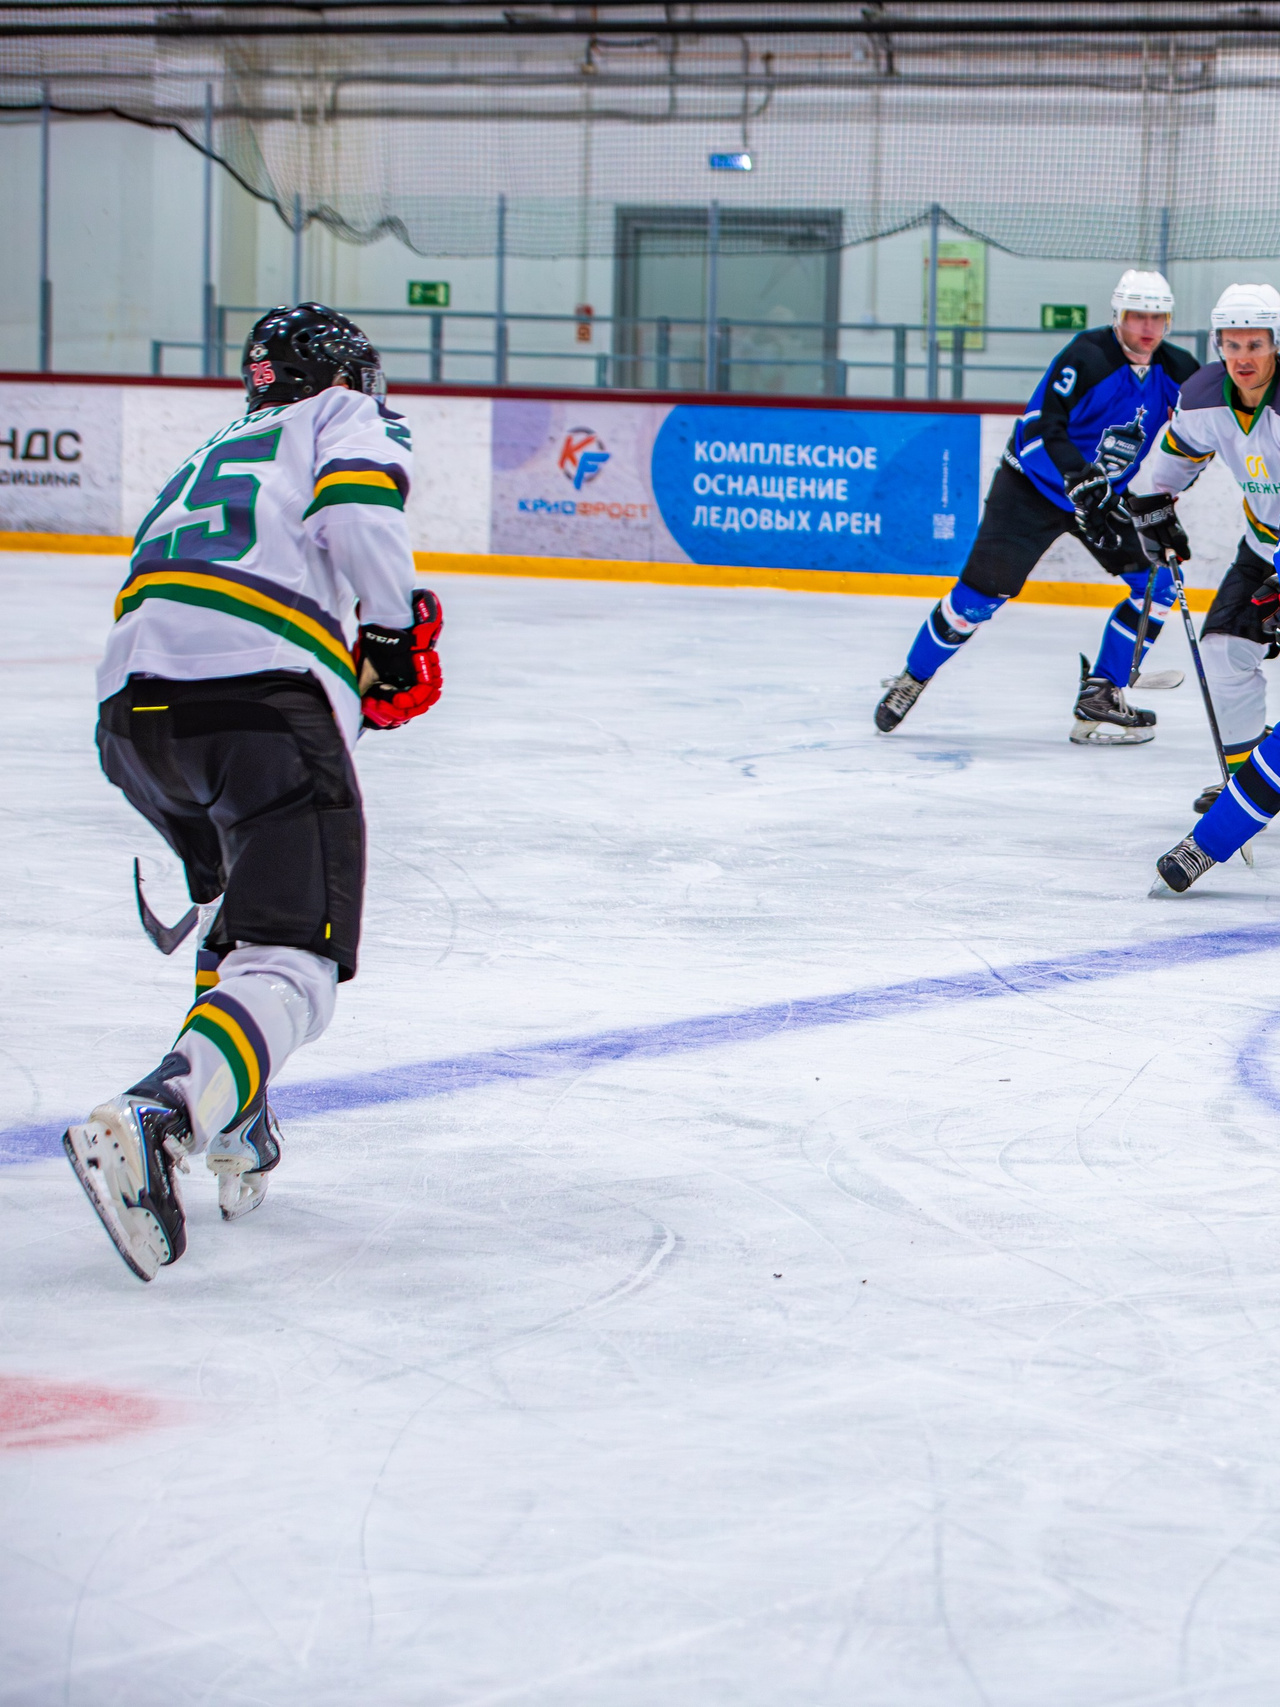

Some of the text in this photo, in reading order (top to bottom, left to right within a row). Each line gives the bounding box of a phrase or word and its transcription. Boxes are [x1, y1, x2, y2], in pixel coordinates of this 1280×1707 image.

[250, 360, 276, 386] 25
[1053, 365, 1077, 397] 3
[694, 441, 877, 470] КОМПЛЕКСНОЕ
[693, 473, 848, 502] ОСНАЩЕНИЕ
[692, 505, 881, 535] ЛЕДОВЫХ АРЕН
[1175, 579, 1189, 611] CCM
